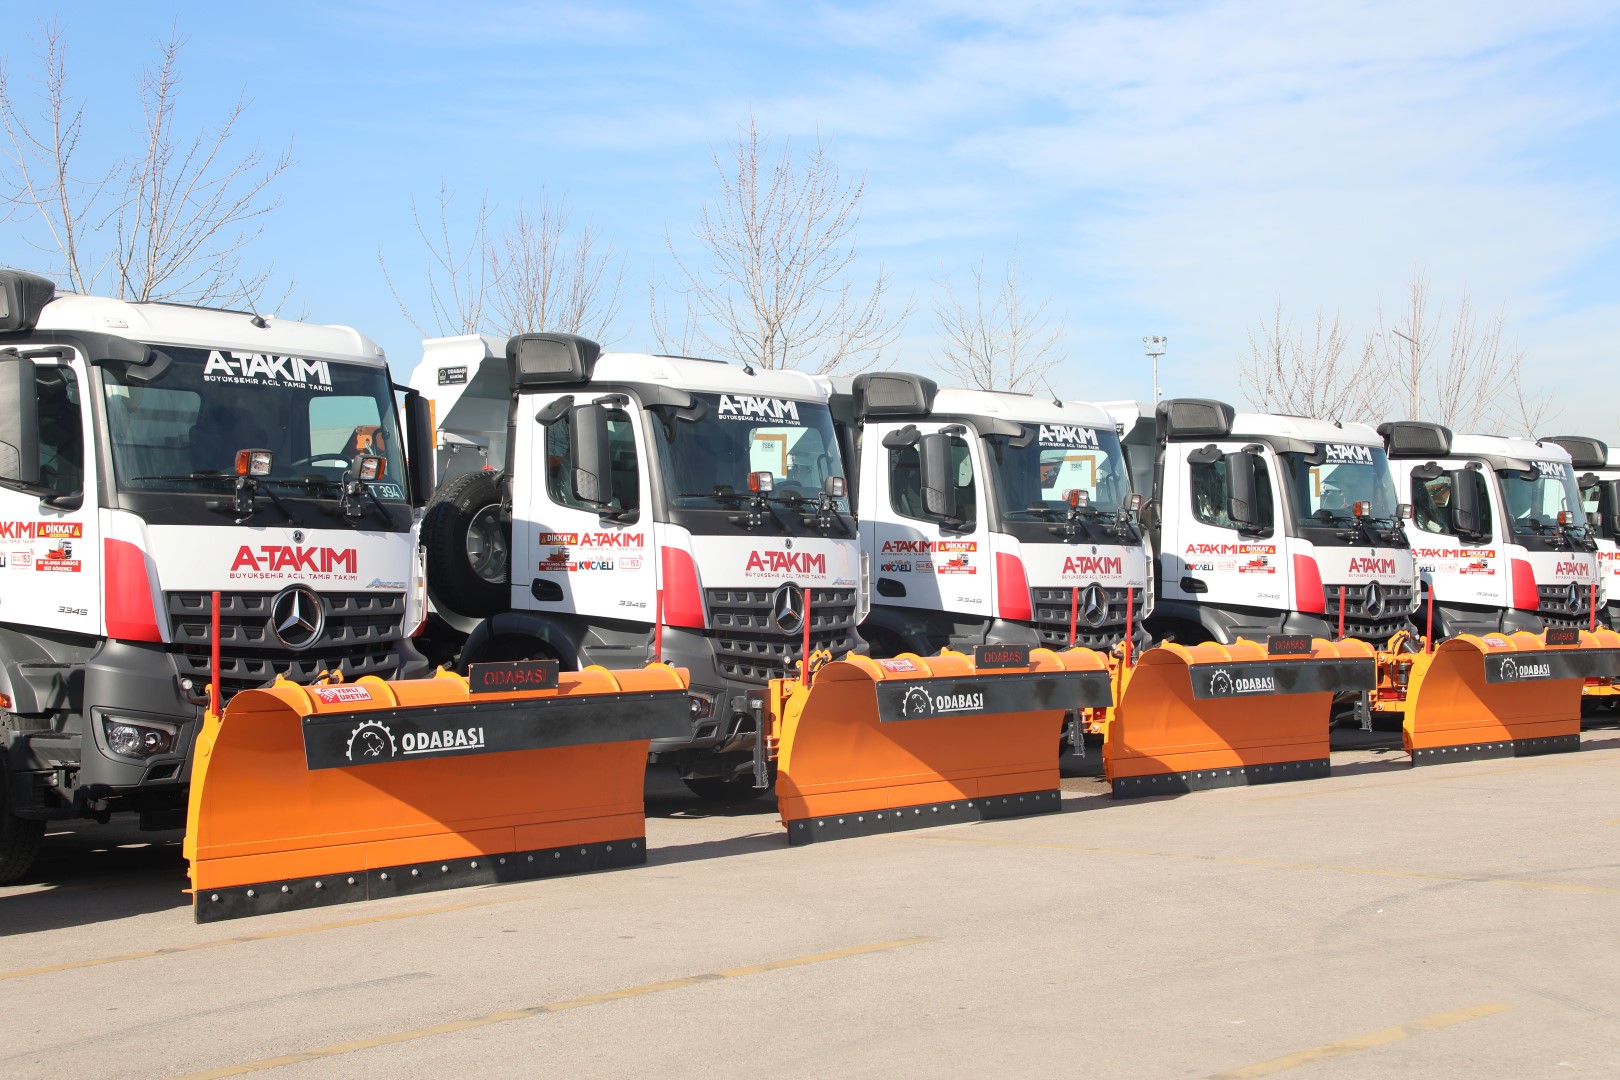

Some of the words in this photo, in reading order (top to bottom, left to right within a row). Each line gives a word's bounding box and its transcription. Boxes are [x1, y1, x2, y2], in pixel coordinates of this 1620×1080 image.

[204, 350, 331, 385] A-TAKIMI
[308, 384, 333, 392] TAKIMI
[718, 394, 800, 420] A-TAKIMI
[1039, 424, 1098, 446] A-TAKIMI
[1325, 444, 1373, 461] A-TAKIMI
[379, 485, 400, 498] 394
[45, 522, 74, 534] DİKKAT
[546, 532, 572, 542] DİKKAT
[580, 532, 644, 548] A-TAKIMI
[881, 540, 937, 553] A-TAKIMI
[945, 541, 971, 550] DİKKAT
[1185, 543, 1238, 555] A-TAKIMI
[230, 545, 358, 574] A-TAKIMI
[745, 550, 827, 575] A-TAKIMI
[1062, 556, 1122, 575] A-TAKIMI
[1349, 557, 1396, 574] A-TAKIMI
[1555, 561, 1590, 577] A-TAKIMI
[936, 693, 984, 711] ODABAŞI
[402, 727, 485, 752] ODABAŞI
